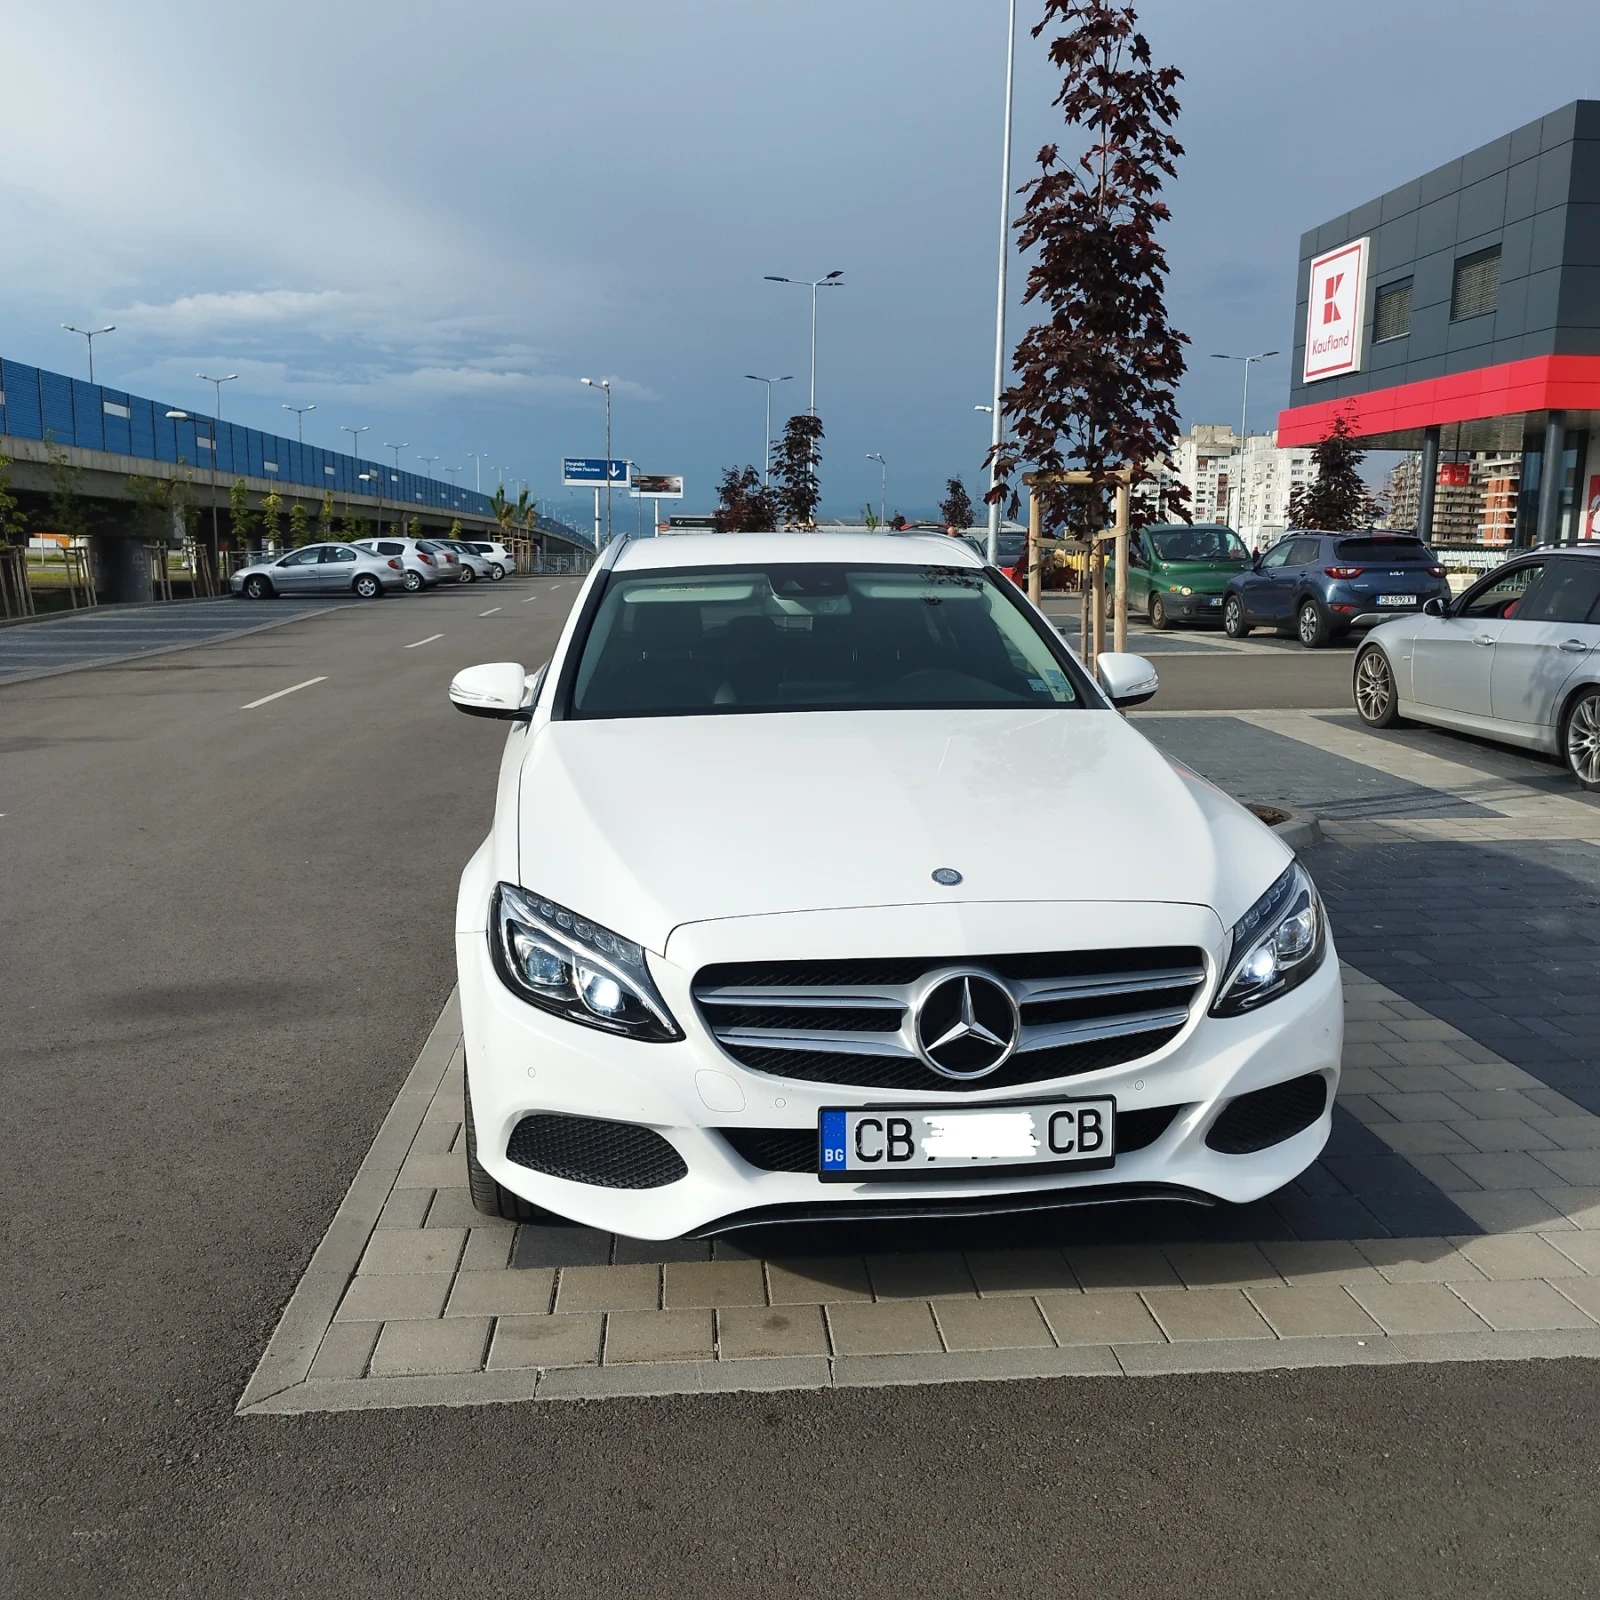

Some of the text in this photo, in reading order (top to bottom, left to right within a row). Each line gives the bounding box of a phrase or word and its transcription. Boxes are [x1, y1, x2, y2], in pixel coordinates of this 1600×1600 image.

[1312, 330, 1349, 355] Kaufland
[855, 1118, 914, 1162] CB
[1048, 1108, 1103, 1154] CB
[825, 1149, 844, 1162] BG
